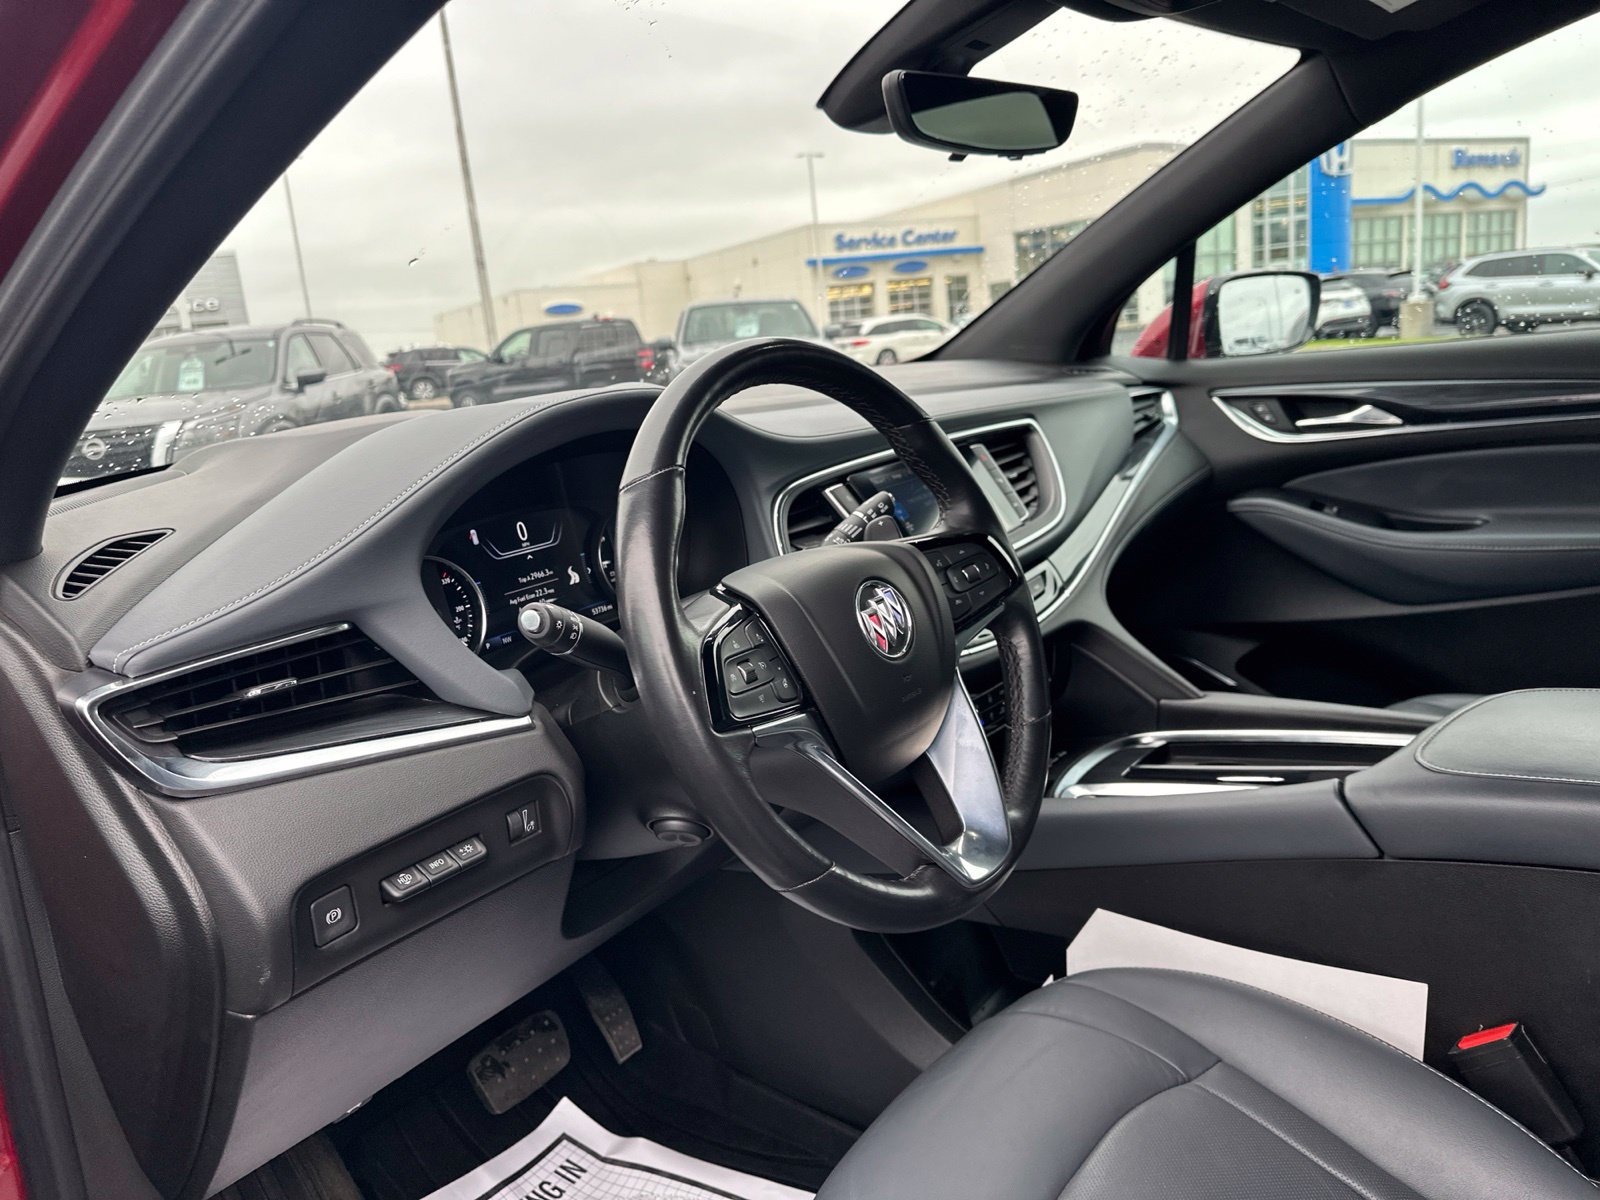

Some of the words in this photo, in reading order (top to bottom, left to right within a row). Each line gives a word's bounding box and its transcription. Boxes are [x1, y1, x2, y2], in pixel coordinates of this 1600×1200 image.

[834, 230, 896, 250] Service
[901, 228, 958, 246] Center
[516, 521, 528, 541] 0
[530, 568, 549, 580] 2966.3
[535, 587, 548, 597] 22.3
[428, 858, 445, 869] INFO
[397, 873, 412, 885] HUD
[553, 1158, 588, 1185] IN
